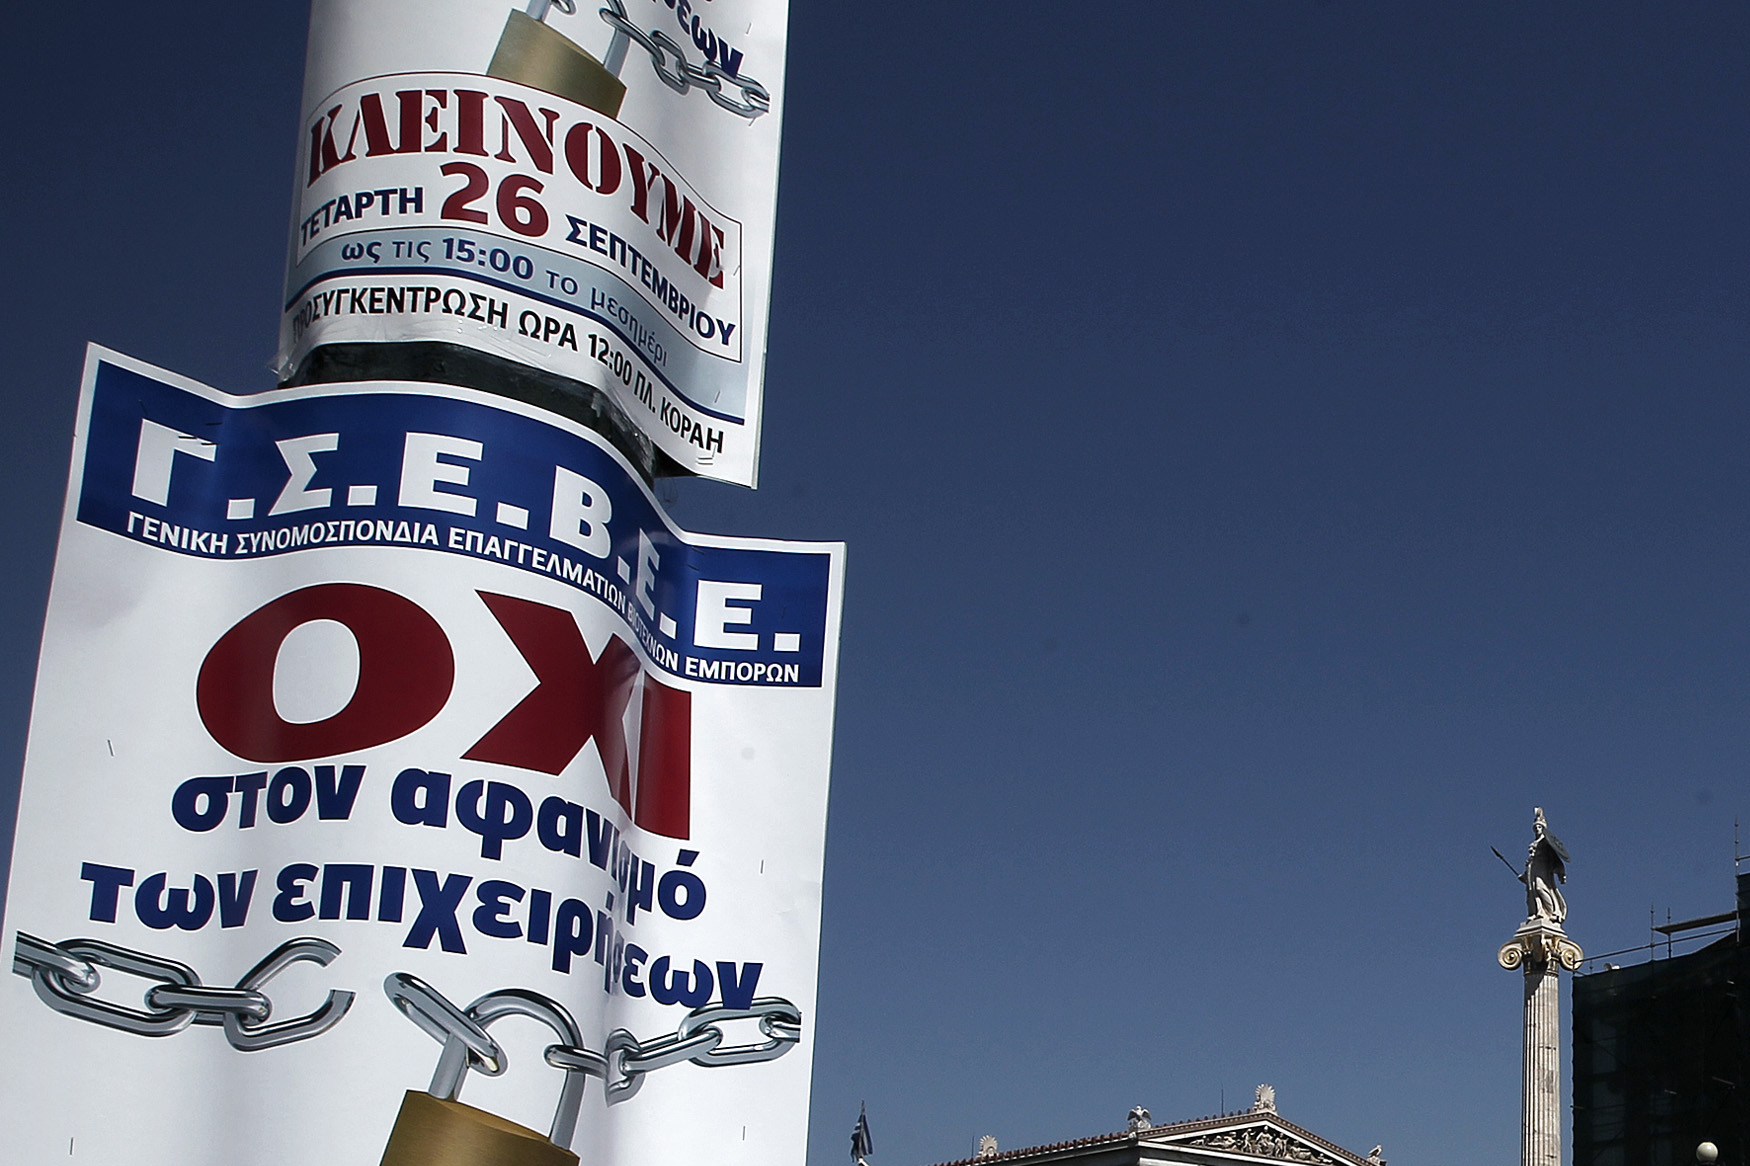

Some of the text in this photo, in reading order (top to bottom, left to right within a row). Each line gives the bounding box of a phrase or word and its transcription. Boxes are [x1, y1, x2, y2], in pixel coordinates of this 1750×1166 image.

[301, 161, 736, 346] ΤΕΤΑΡΤΗ 26 ΣΕΠΤΕΜΒΡΙΟΥ
[306, 88, 725, 289] ΚΛΕΙΝΟΥΜΕ
[341, 237, 669, 372] ως τις 15:00 το μεσημέρι
[518, 310, 578, 352] ΩΡΑ
[588, 334, 632, 386] 12:00
[635, 370, 656, 414] ΠΛ.
[660, 396, 724, 454] ΚΟΡΑΗ
[127, 510, 228, 555] ΓΕΝΙΚΗ
[234, 519, 439, 555] ΣΥΝΟΜΟΣΠΟΝΔΙΑ
[448, 527, 626, 614] ΕΠΑΓΓΕΛΜΑΤΙΩΝ
[685, 656, 800, 684] ΕΜΠΟΡΩΝ
[195, 582, 692, 841] ΟΧΙ
[171, 764, 707, 926] στον αφανισμό
[80, 861, 764, 1011] των επιχειρήσεων
